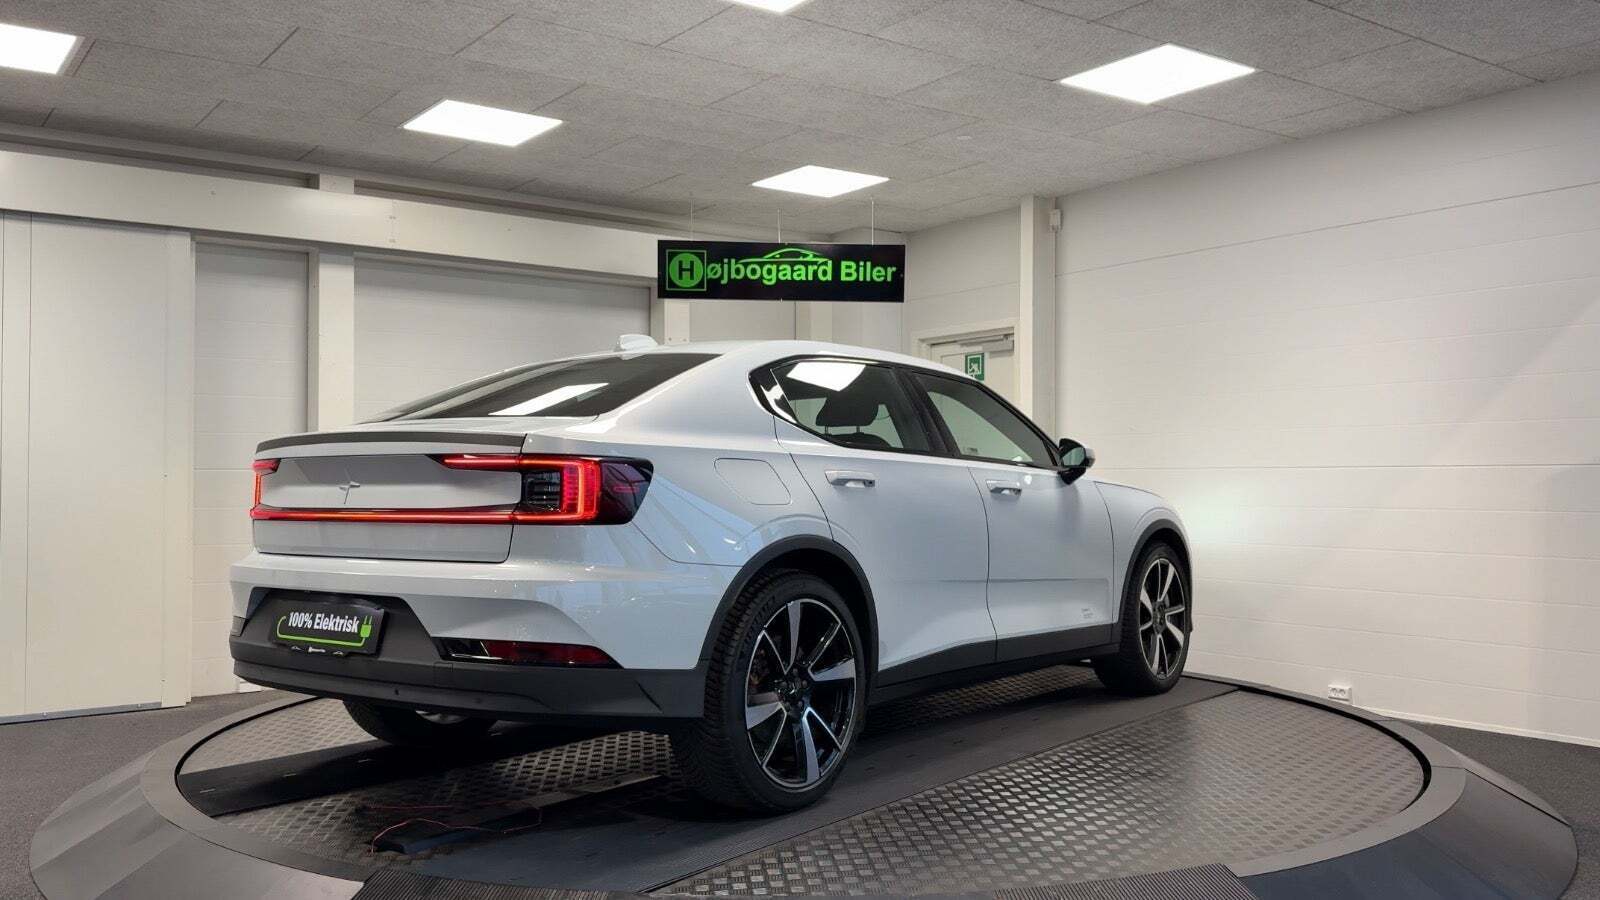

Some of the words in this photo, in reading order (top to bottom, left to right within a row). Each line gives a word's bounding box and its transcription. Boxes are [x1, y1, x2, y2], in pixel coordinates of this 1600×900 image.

[677, 259, 833, 285] Højbogaard
[840, 261, 897, 282] Biler
[288, 611, 313, 629] 100%
[313, 613, 360, 633] Elektrisk
